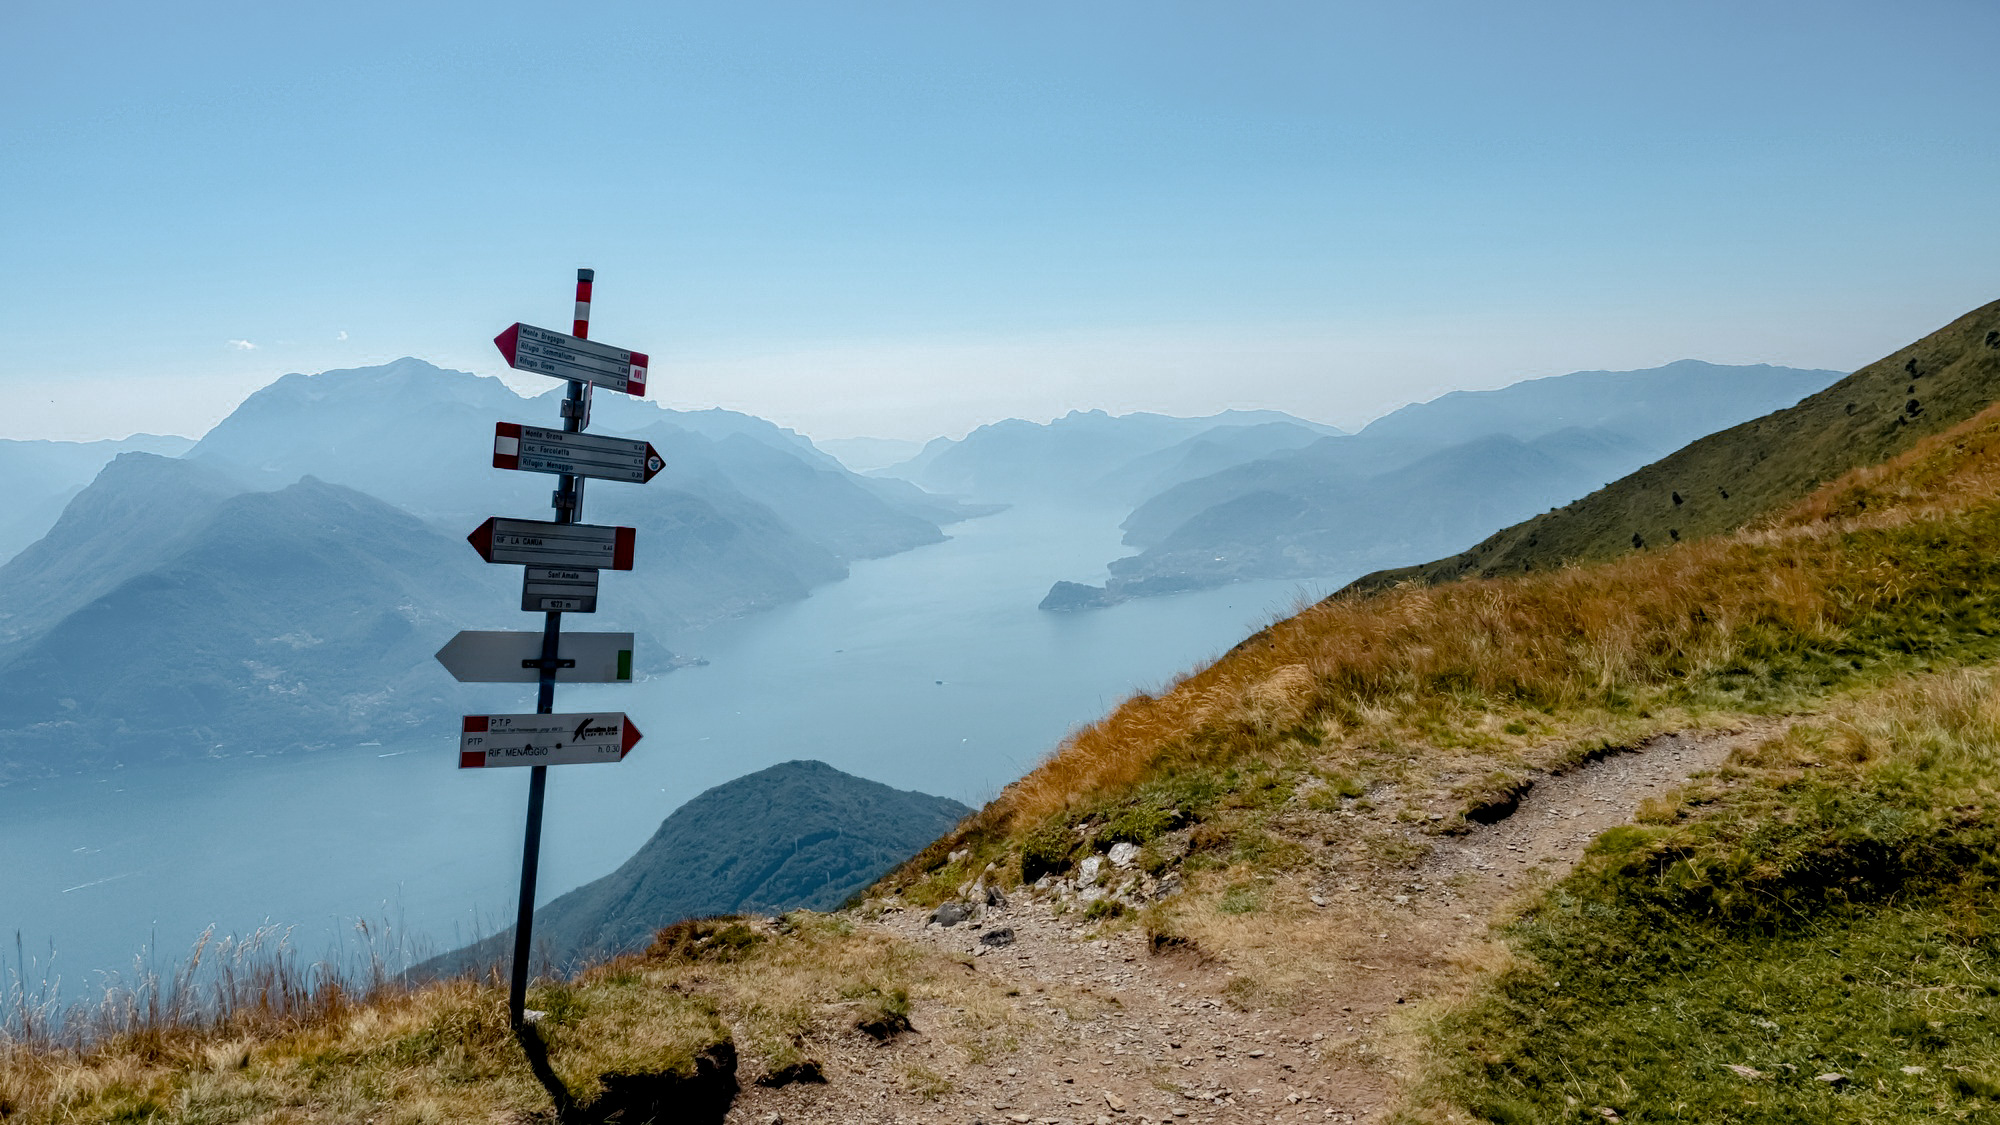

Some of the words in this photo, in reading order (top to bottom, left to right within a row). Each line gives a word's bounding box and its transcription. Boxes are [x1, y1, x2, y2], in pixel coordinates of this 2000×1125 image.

[522, 328, 538, 338] Monte
[541, 332, 566, 345] Bregagno
[520, 341, 540, 353] Rifugio
[518, 356, 538, 368] Rifugio
[525, 429, 543, 438] Monte
[522, 457, 544, 468] Rifugio
[546, 461, 574, 472] Menaggio
[510, 536, 520, 545] LA
[467, 737, 483, 746] PTP
[505, 747, 549, 757] MENAGGIO
